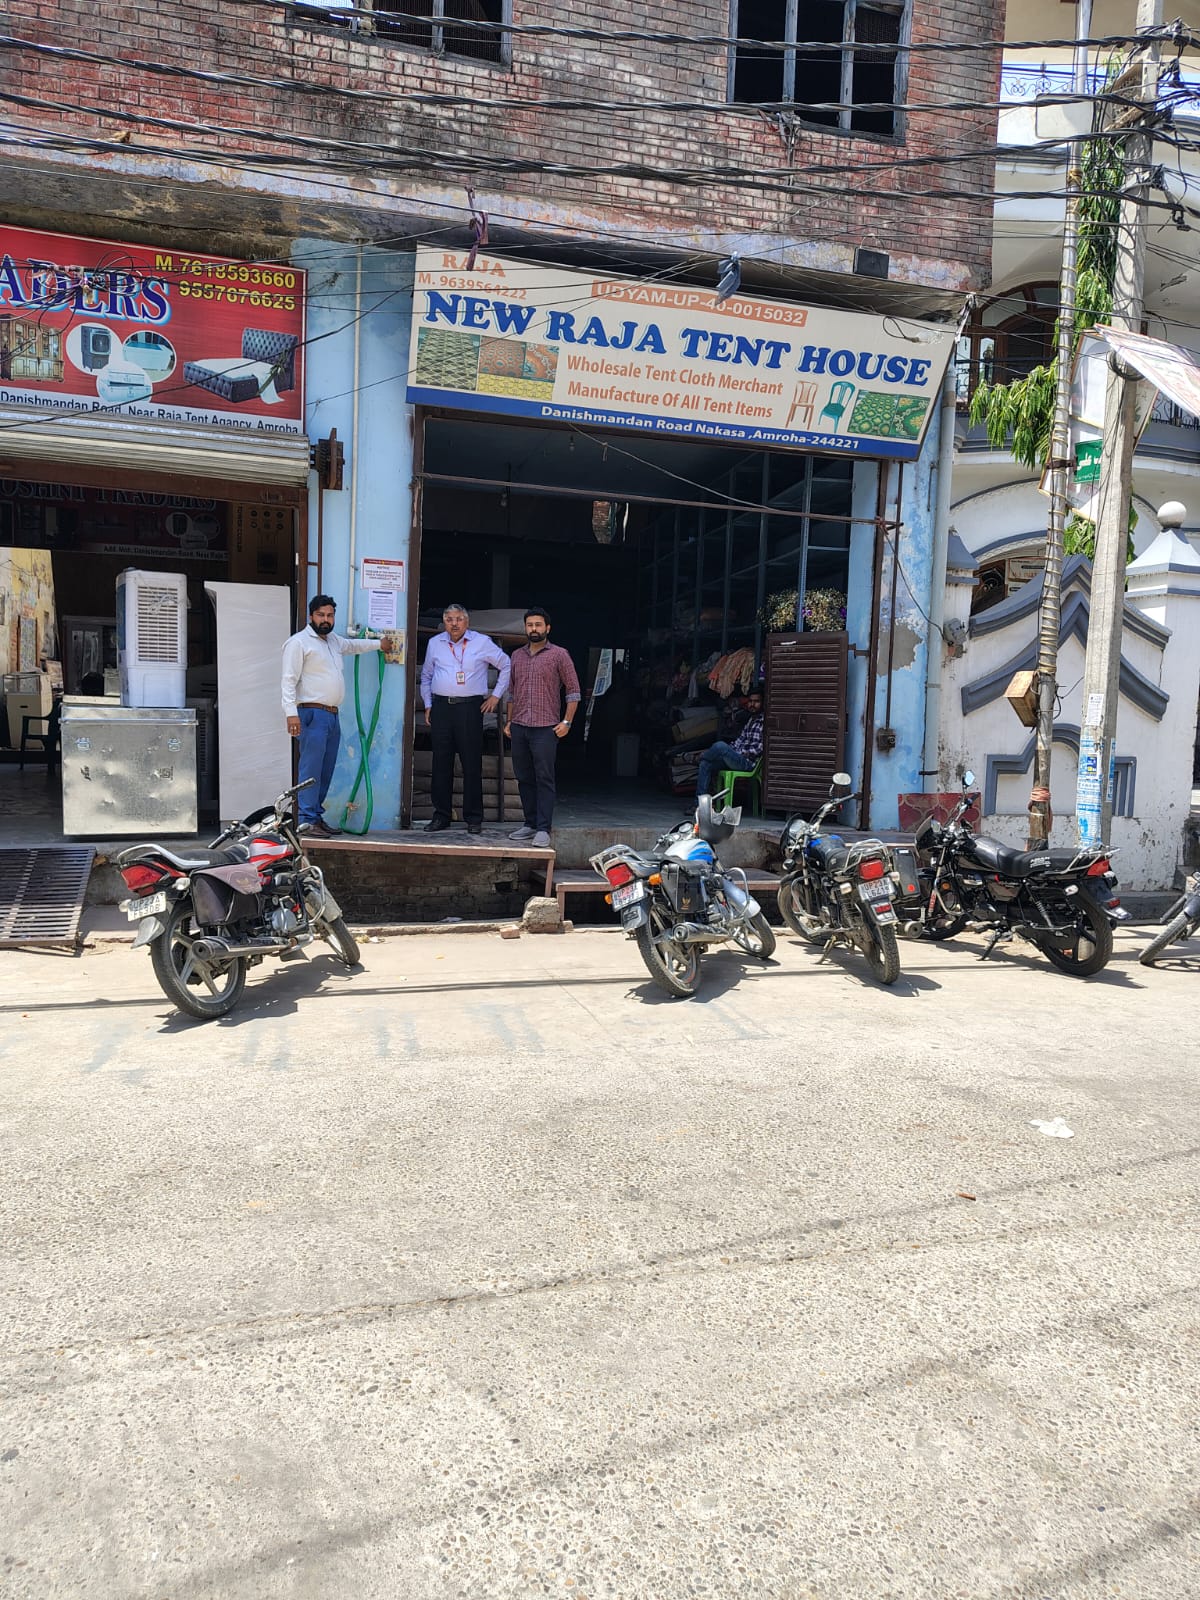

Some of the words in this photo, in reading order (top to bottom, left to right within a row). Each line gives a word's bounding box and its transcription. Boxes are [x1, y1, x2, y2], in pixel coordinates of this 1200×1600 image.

[179, 280, 295, 311] 9557676625
[418, 271, 436, 285] M.
[440, 275, 527, 300] 9639564222
[597, 282, 804, 325] UDYAM-UP-40-0015032
[425, 290, 536, 335] NEW
[546, 311, 667, 354] RAJA
[681, 328, 791, 369] TENT
[798, 345, 931, 386] HOUSE
[567, 355, 641, 378] Wholesale
[645, 365, 676, 383] Tent
[679, 369, 716, 387] Cloth
[718, 374, 783, 395] Merchant
[567, 381, 659, 405] Manufacture
[663, 392, 680, 408] Of
[681, 395, 700, 410] All
[703, 397, 734, 414] Tent
[735, 401, 773, 418] Items
[541, 406, 652, 428] Danishmandan
[656, 418, 693, 432] Road
[696, 424, 745, 438] Nakasa
